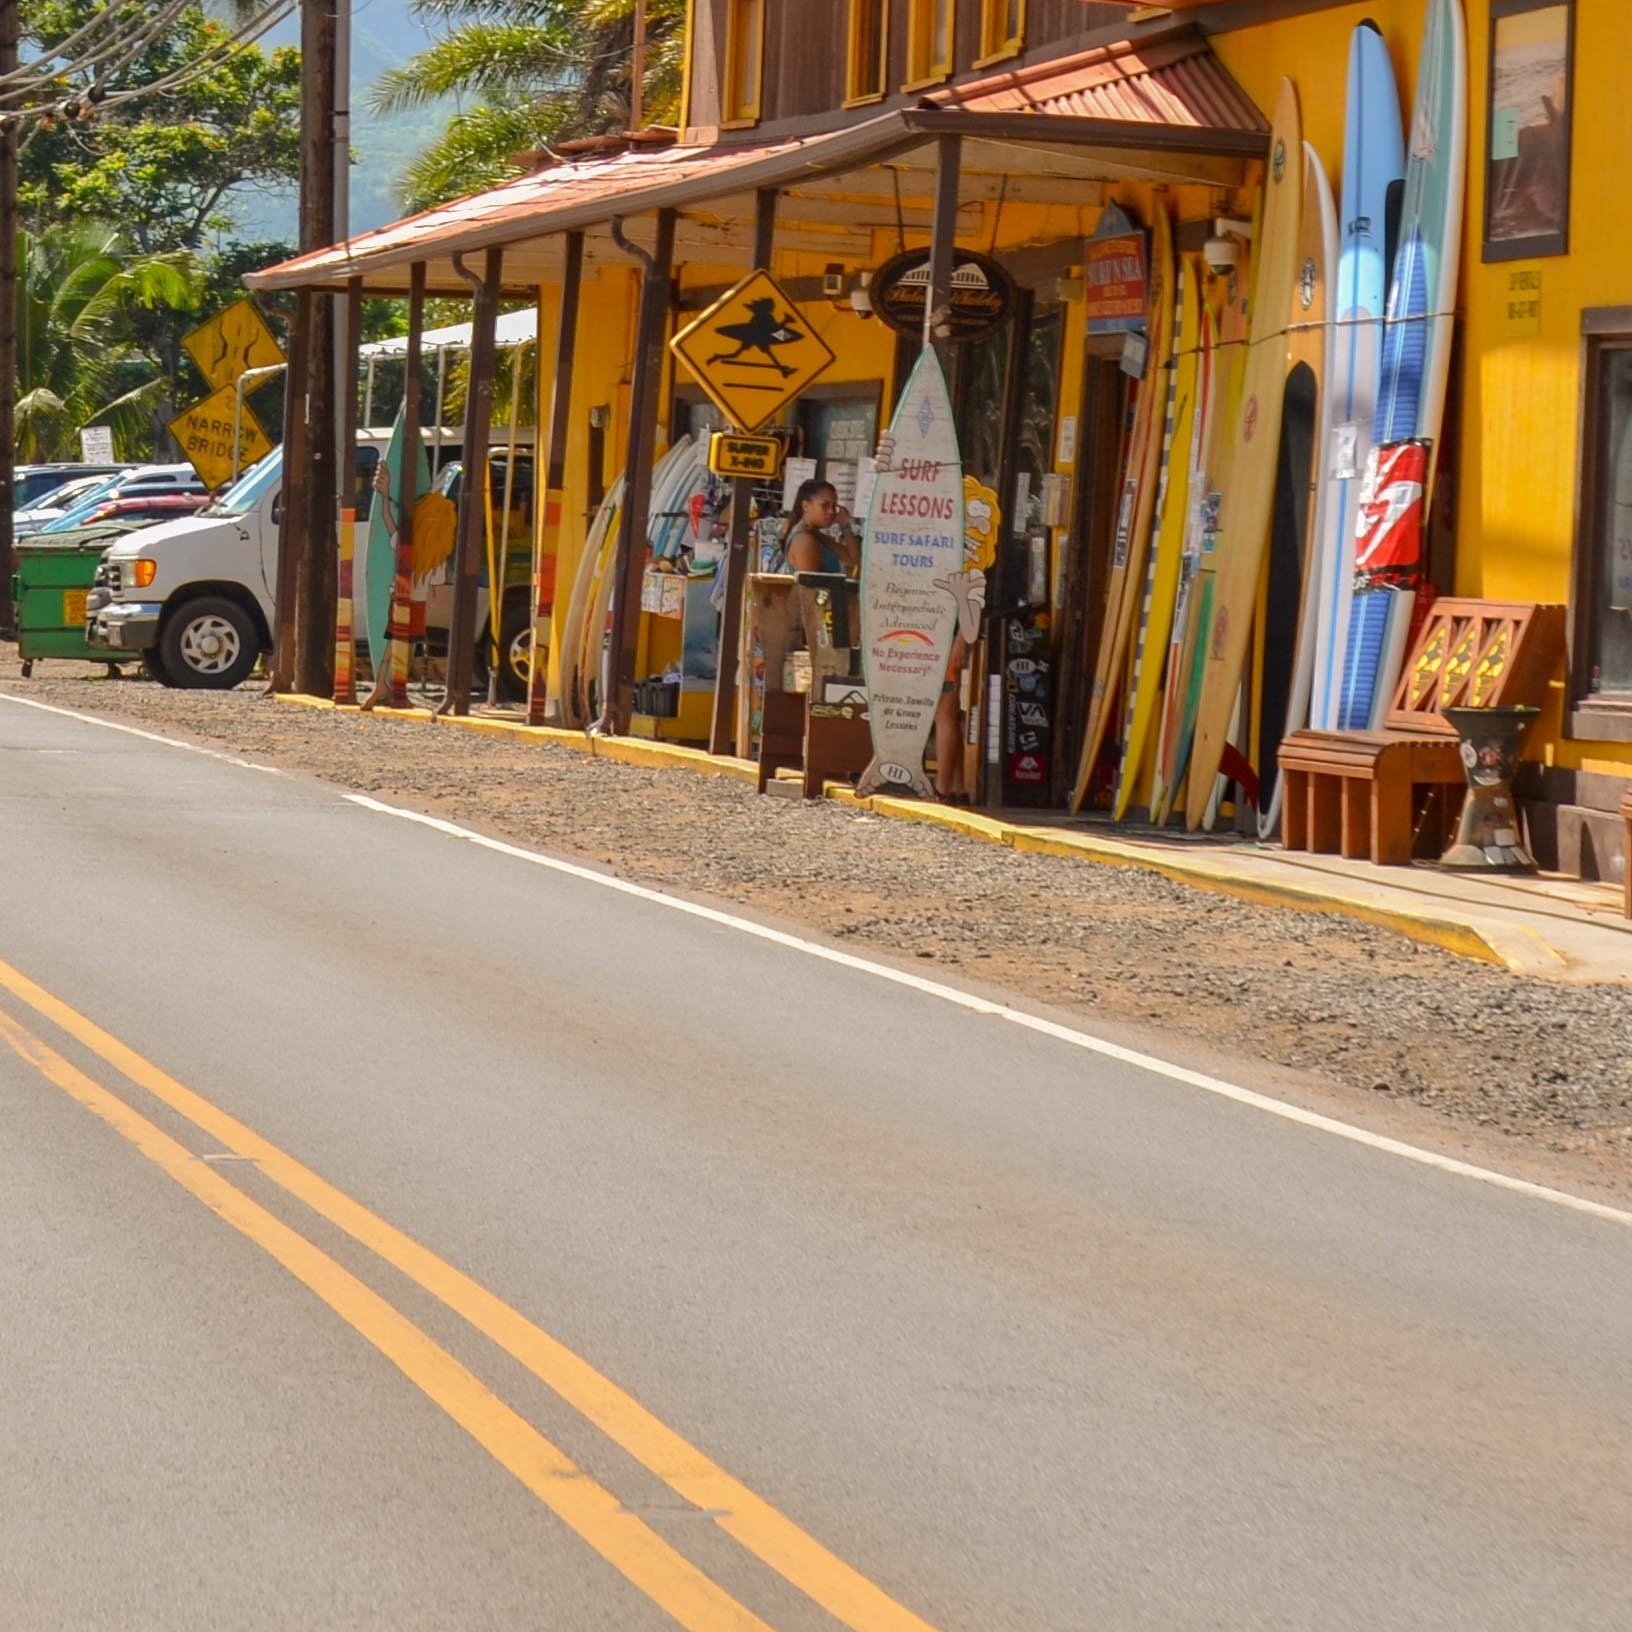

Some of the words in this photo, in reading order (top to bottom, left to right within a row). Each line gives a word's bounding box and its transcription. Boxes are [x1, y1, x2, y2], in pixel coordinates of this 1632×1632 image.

[899, 458, 943, 483] SURF
[880, 492, 955, 520] LESSONS
[874, 531, 907, 546] SURF
[909, 533, 954, 549] SAFARI
[892, 553, 934, 568] TOURS
[872, 647, 886, 658] No
[887, 648, 940, 663] Experience
